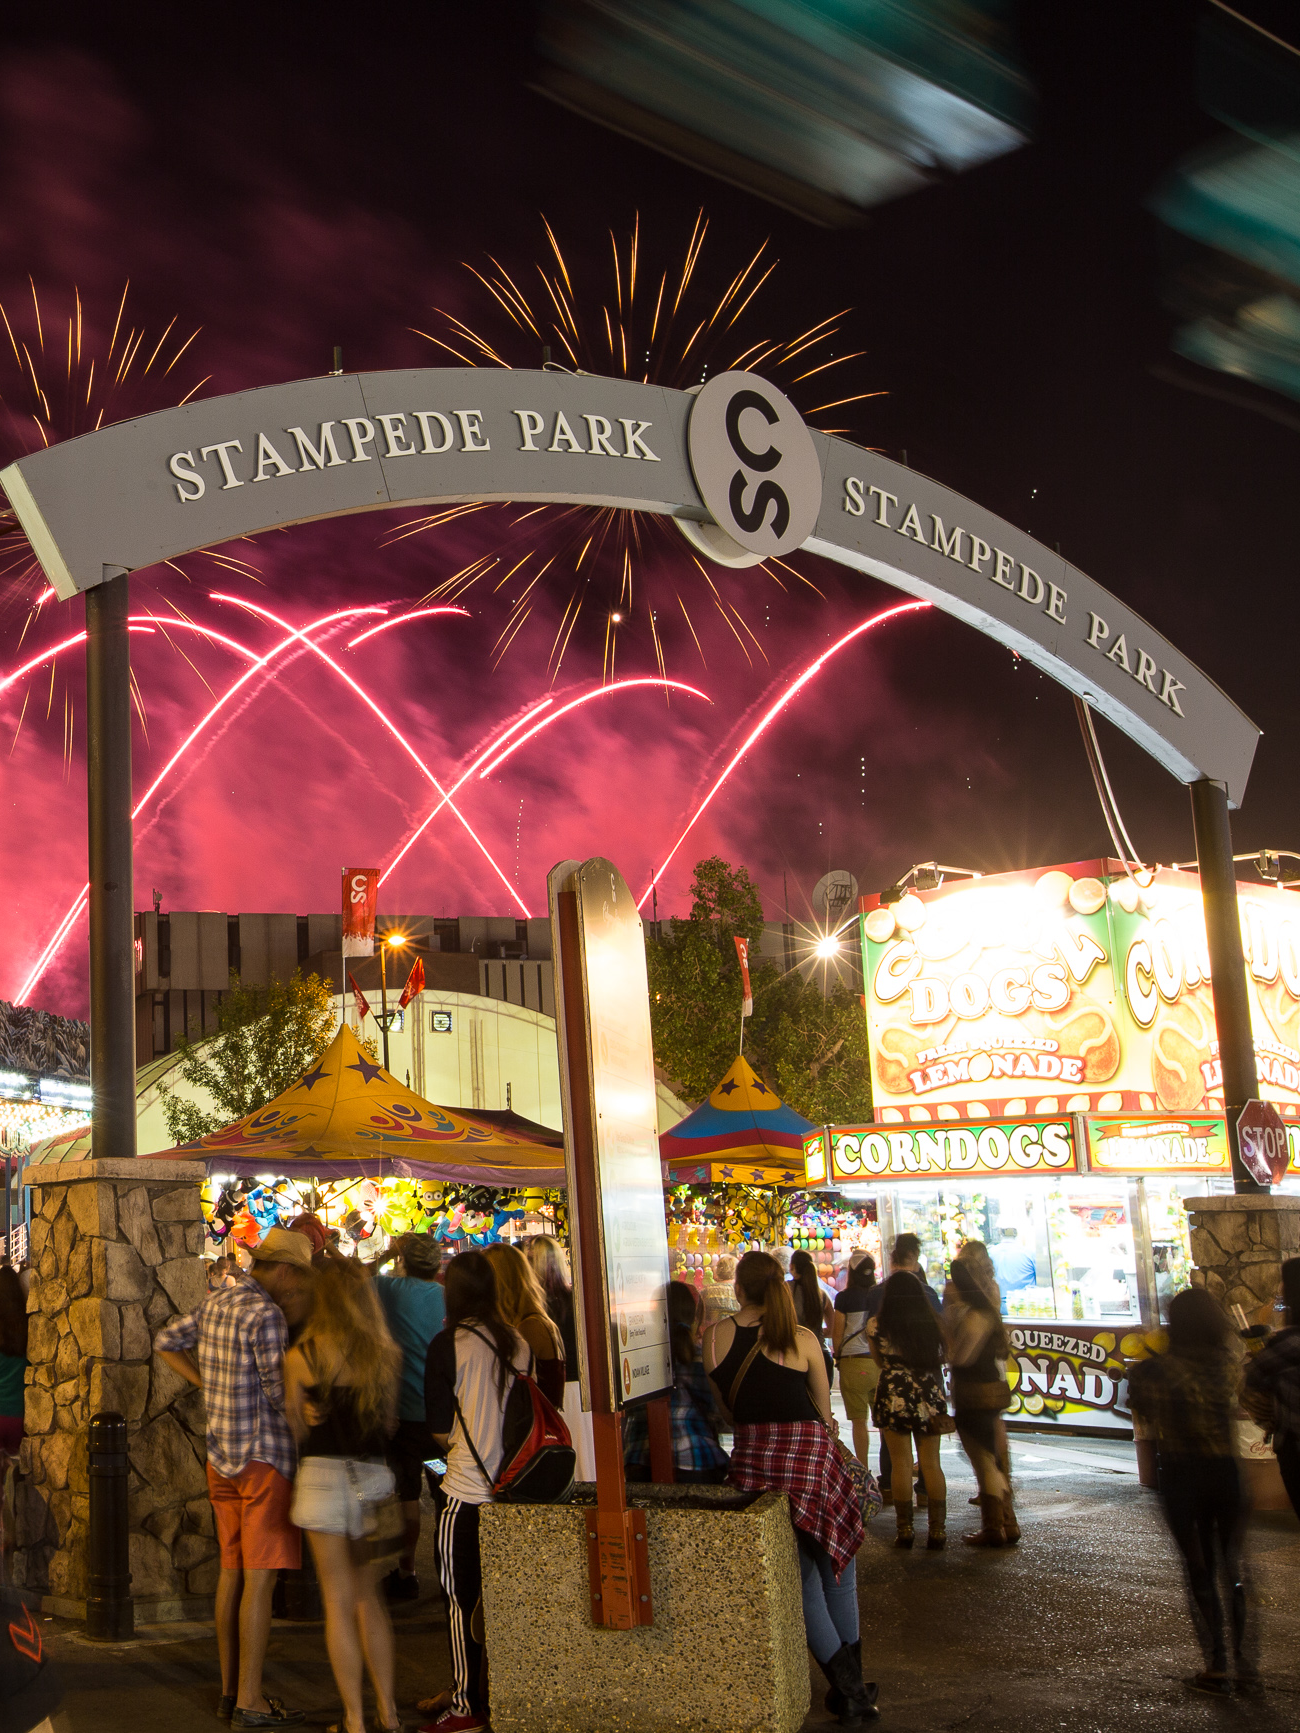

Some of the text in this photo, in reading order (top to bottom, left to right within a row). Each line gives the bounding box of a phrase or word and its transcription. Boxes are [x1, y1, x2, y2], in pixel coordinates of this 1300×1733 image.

[169, 409, 662, 503] STAMPEDE PARK
[844, 476, 1187, 718] STAMPEDE PARK
[907, 962, 1071, 1025] DOGS
[910, 1051, 1083, 1094] LEMONADE
[916, 1037, 1059, 1064] FRESH SQUEEZED
[835, 1123, 1071, 1175] CORNDOGS
[1242, 1126, 1285, 1159] STOP
[1008, 1328, 1107, 1363] QUEEZED
